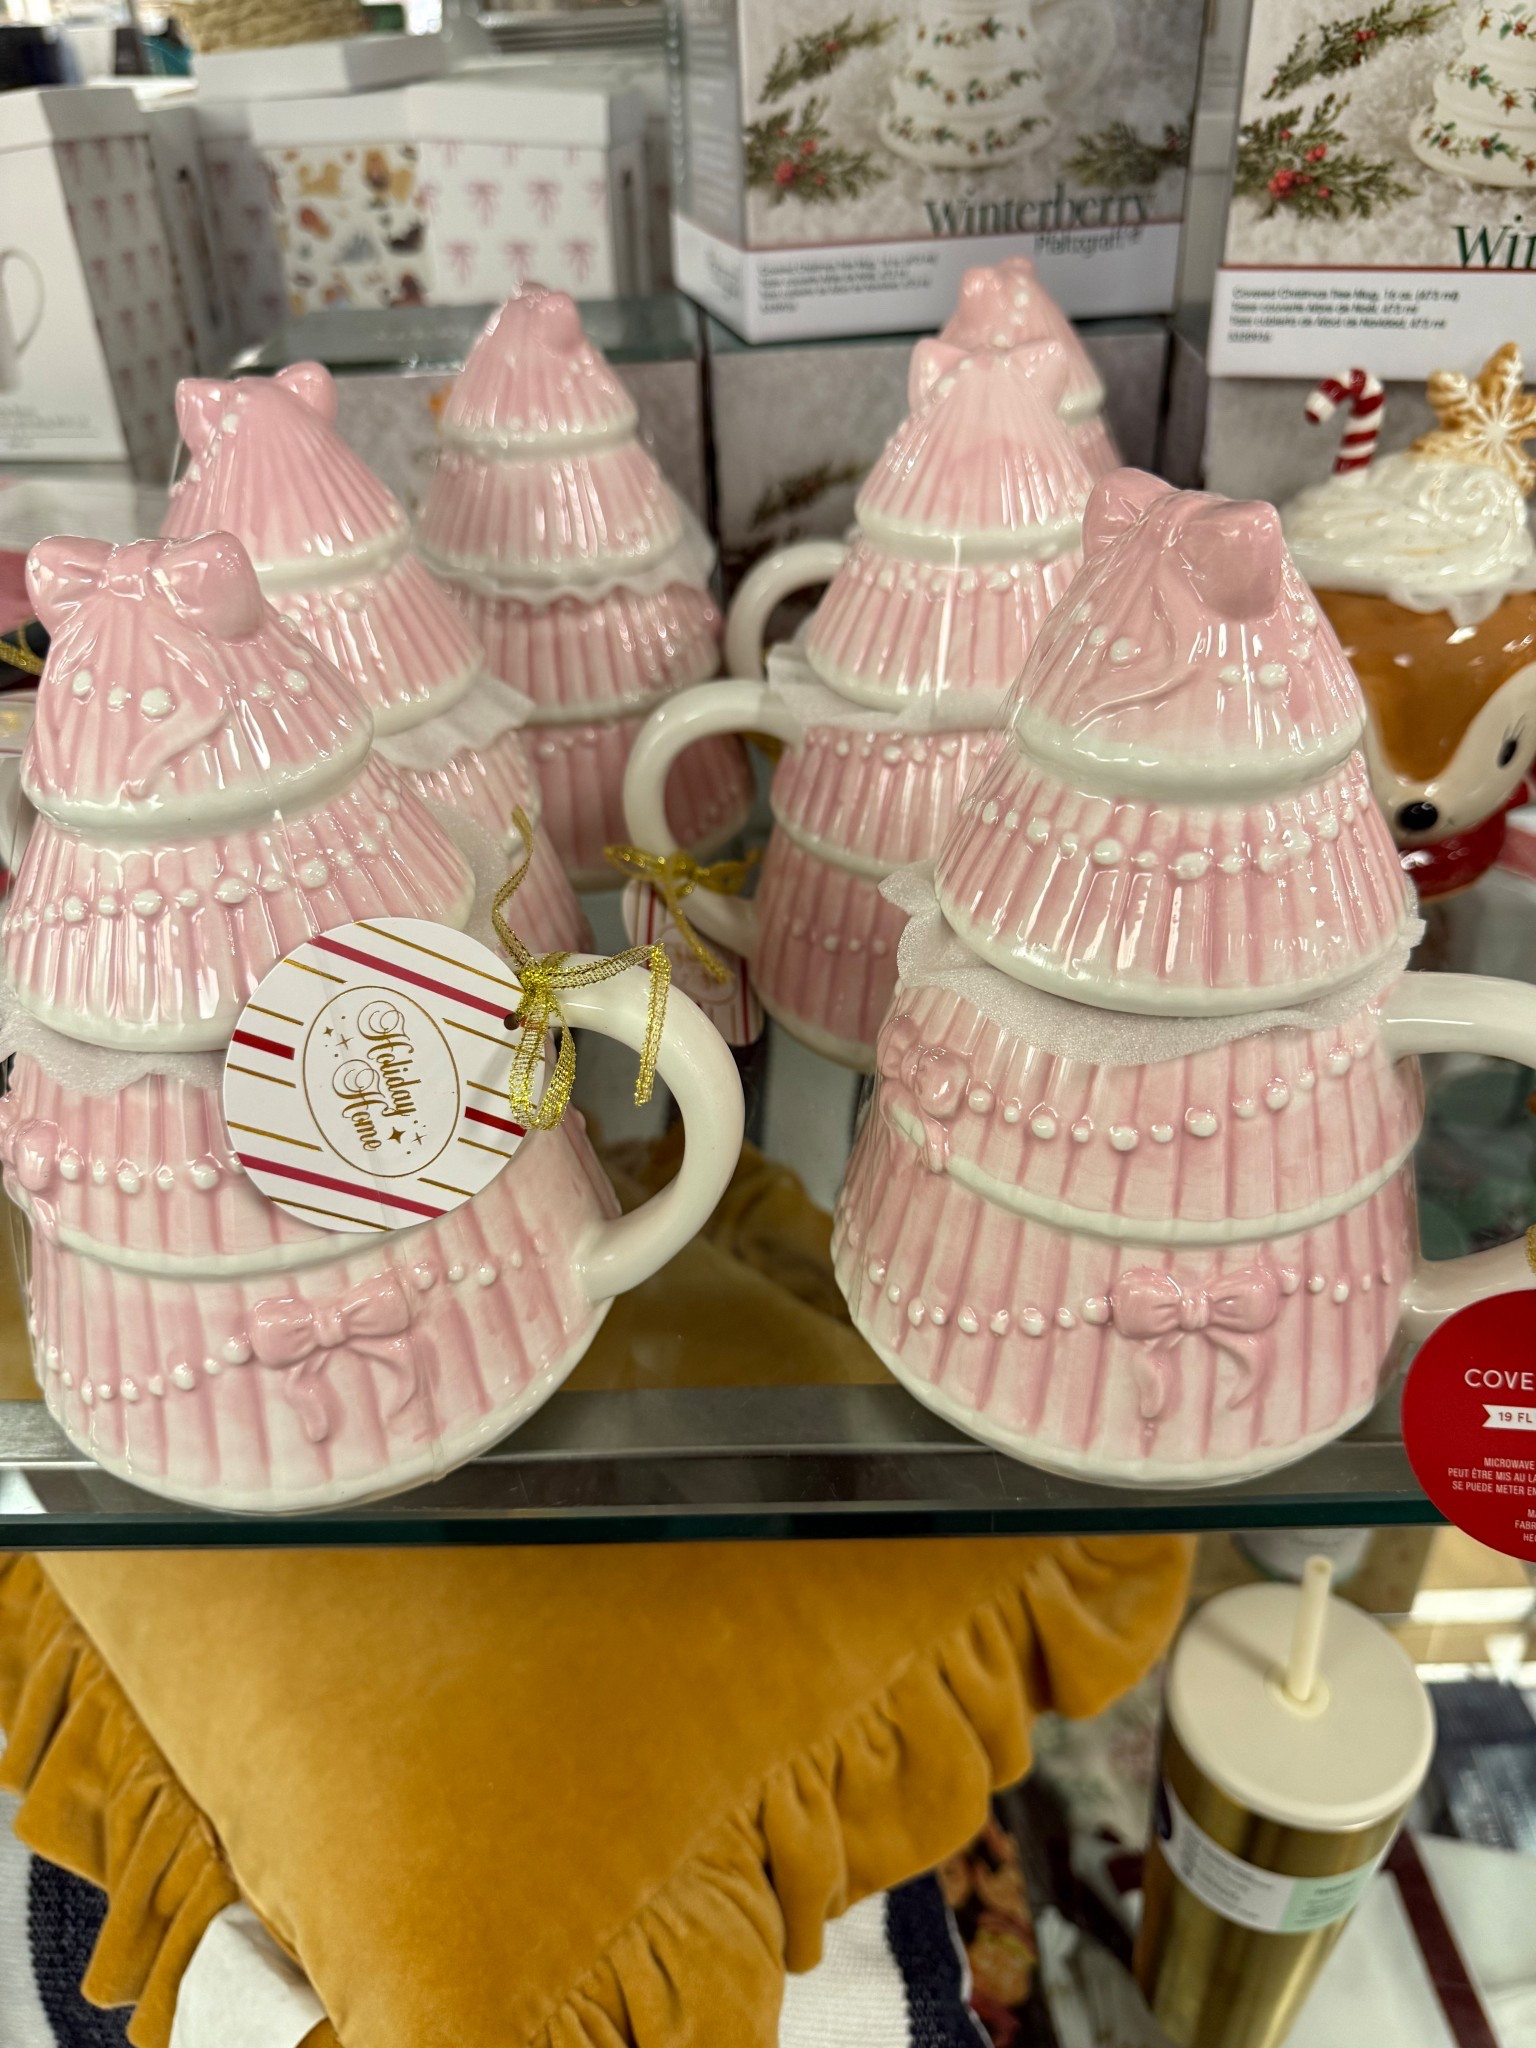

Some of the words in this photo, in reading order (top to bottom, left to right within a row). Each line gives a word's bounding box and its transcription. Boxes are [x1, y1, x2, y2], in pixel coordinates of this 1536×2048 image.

[923, 182, 1154, 238] Winterberry
[356, 999, 422, 1118] Holiday
[331, 1058, 388, 1152] Home
[1464, 1368, 1535, 1391] COVE
[1497, 1411, 1512, 1422] 19
[1518, 1412, 1533, 1424] FL
[1483, 1457, 1535, 1470] MICROWAVE
[1448, 1467, 1469, 1479] PEUT
[1471, 1467, 1494, 1480] ÊTRE
[1495, 1471, 1511, 1482] MIS
[1513, 1472, 1525, 1483] AU
[1452, 1480, 1464, 1490] SE
[1465, 1481, 1493, 1493] PUEDE
[1495, 1484, 1525, 1495] METER
